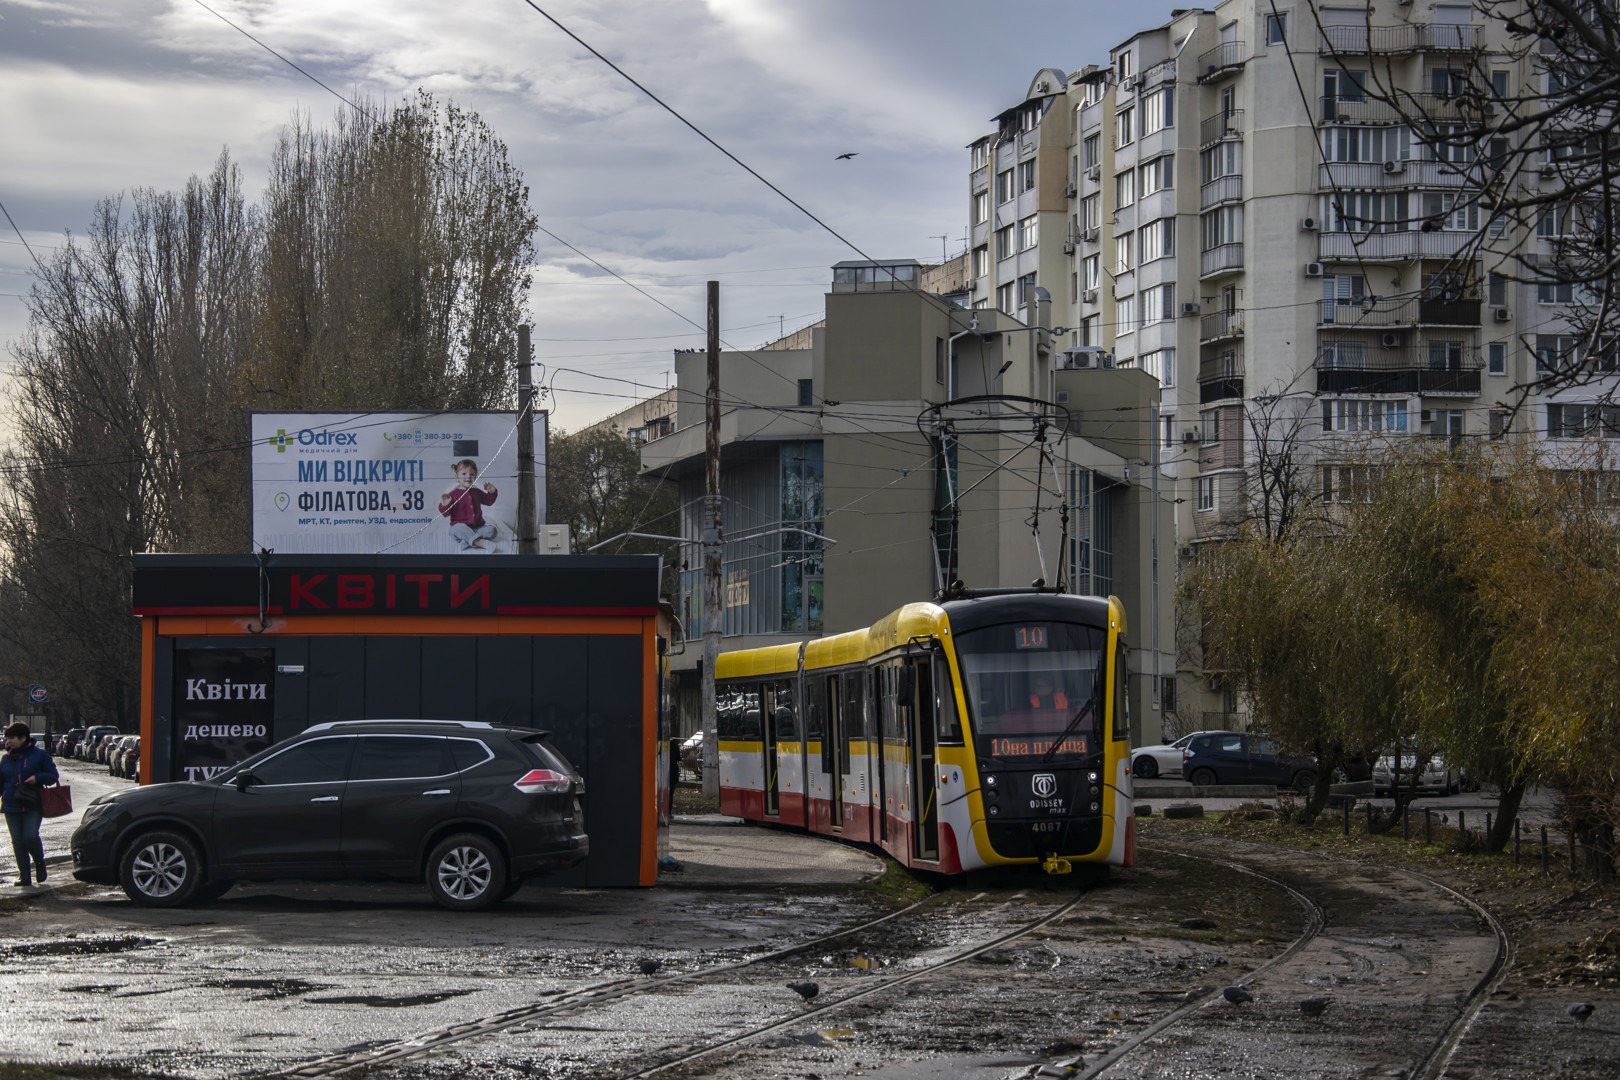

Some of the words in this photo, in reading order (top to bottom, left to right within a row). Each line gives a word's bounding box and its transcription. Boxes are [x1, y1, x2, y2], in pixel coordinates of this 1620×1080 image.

[298, 429, 357, 446] Odrex
[298, 460, 327, 482] МИ
[334, 459, 424, 485] ВІДКРИТІ
[298, 490, 397, 513] ФІЛАТОВА,
[402, 490, 425, 511] 38
[298, 518, 317, 526] МРТ,
[319, 518, 333, 526] КТ,
[334, 518, 367, 527] рентген,
[368, 516, 388, 526] УЗД,
[290, 574, 490, 609] КВІТИ
[1019, 626, 1043, 647] 10
[186, 678, 267, 700] Квіти
[184, 724, 267, 741] дешево
[991, 738, 1029, 756] 10на
[1029, 799, 1063, 808] ODISSEY
